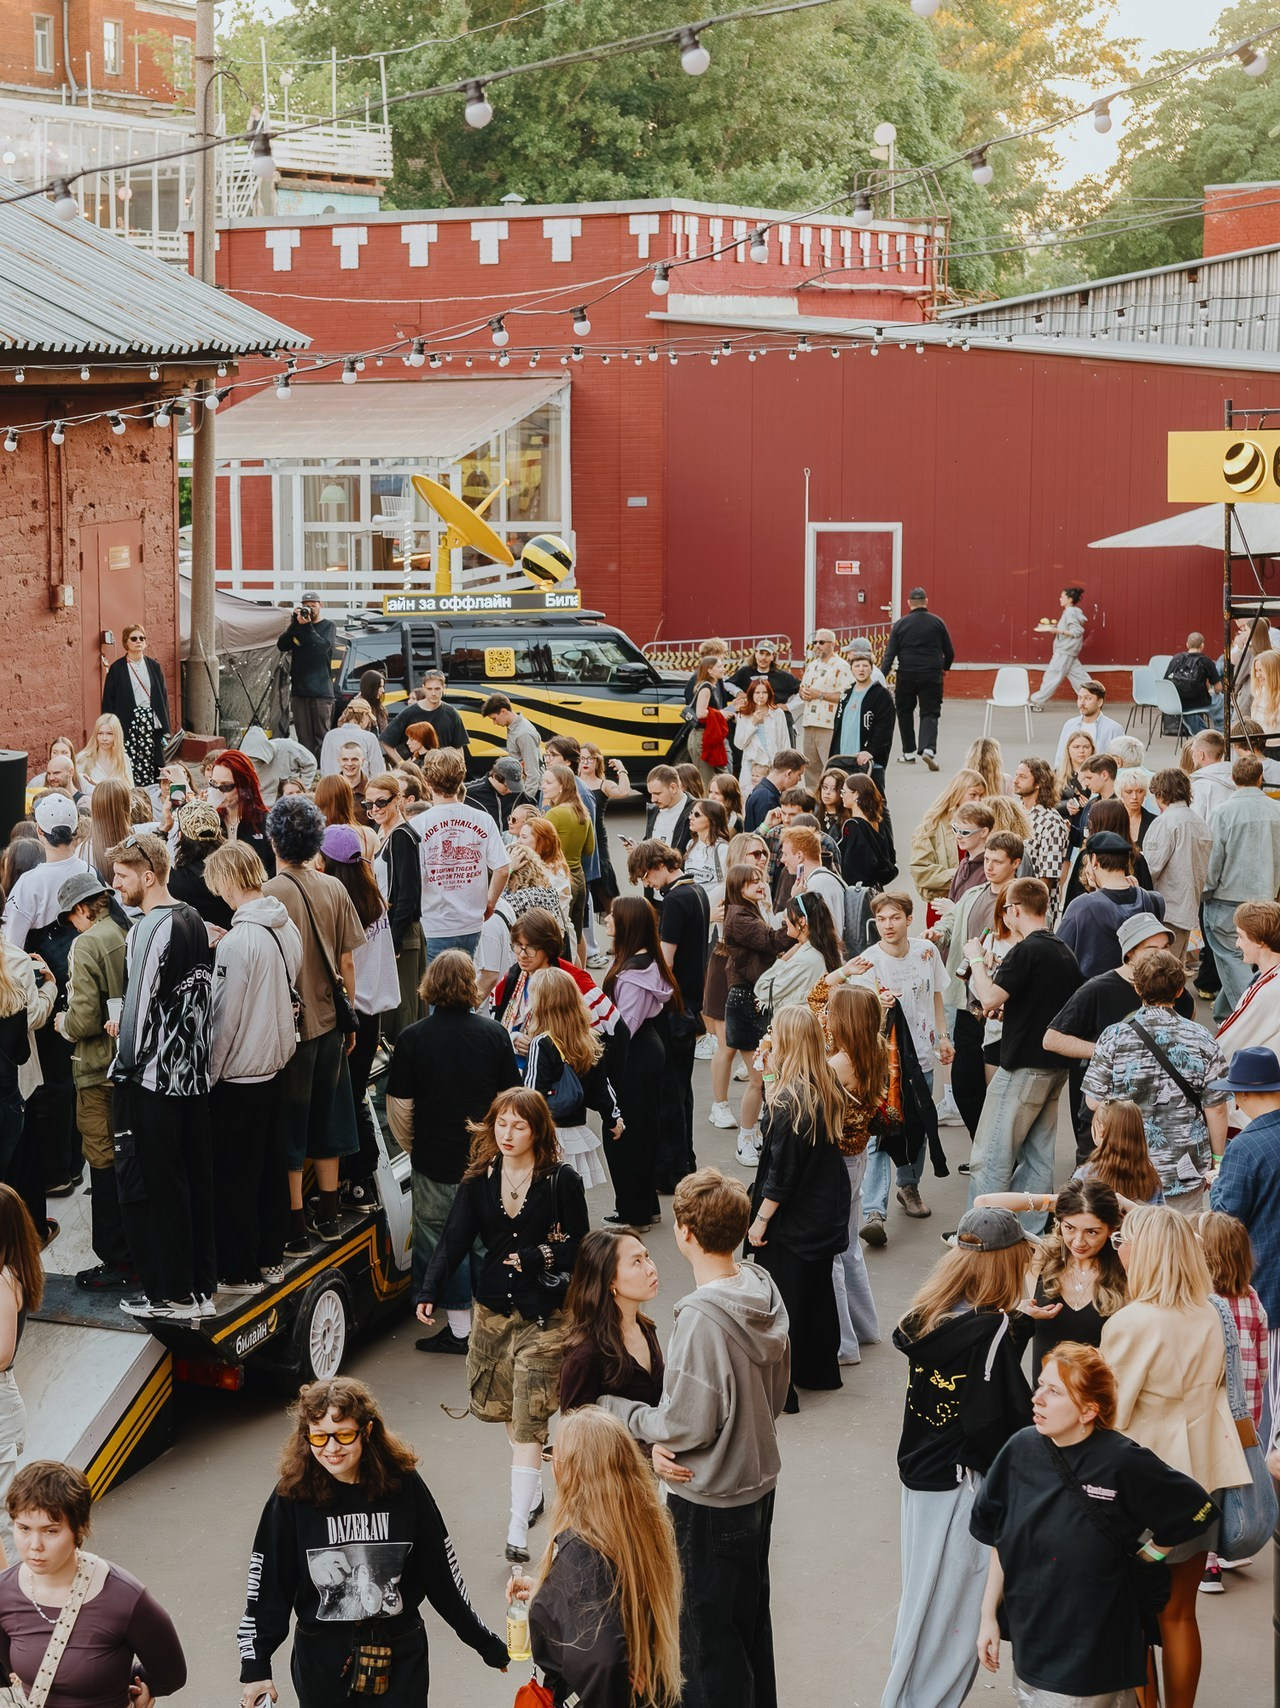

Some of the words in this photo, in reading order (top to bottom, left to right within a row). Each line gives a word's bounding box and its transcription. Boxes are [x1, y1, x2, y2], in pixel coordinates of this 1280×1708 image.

[419, 598, 436, 610] за
[439, 594, 512, 612] оффлайн
[423, 824, 439, 843] ADE
[440, 820, 449, 828] IN
[450, 819, 488, 839] THAILAND
[236, 1322, 267, 1355] билайн
[326, 1512, 390, 1545] DAZERAW
